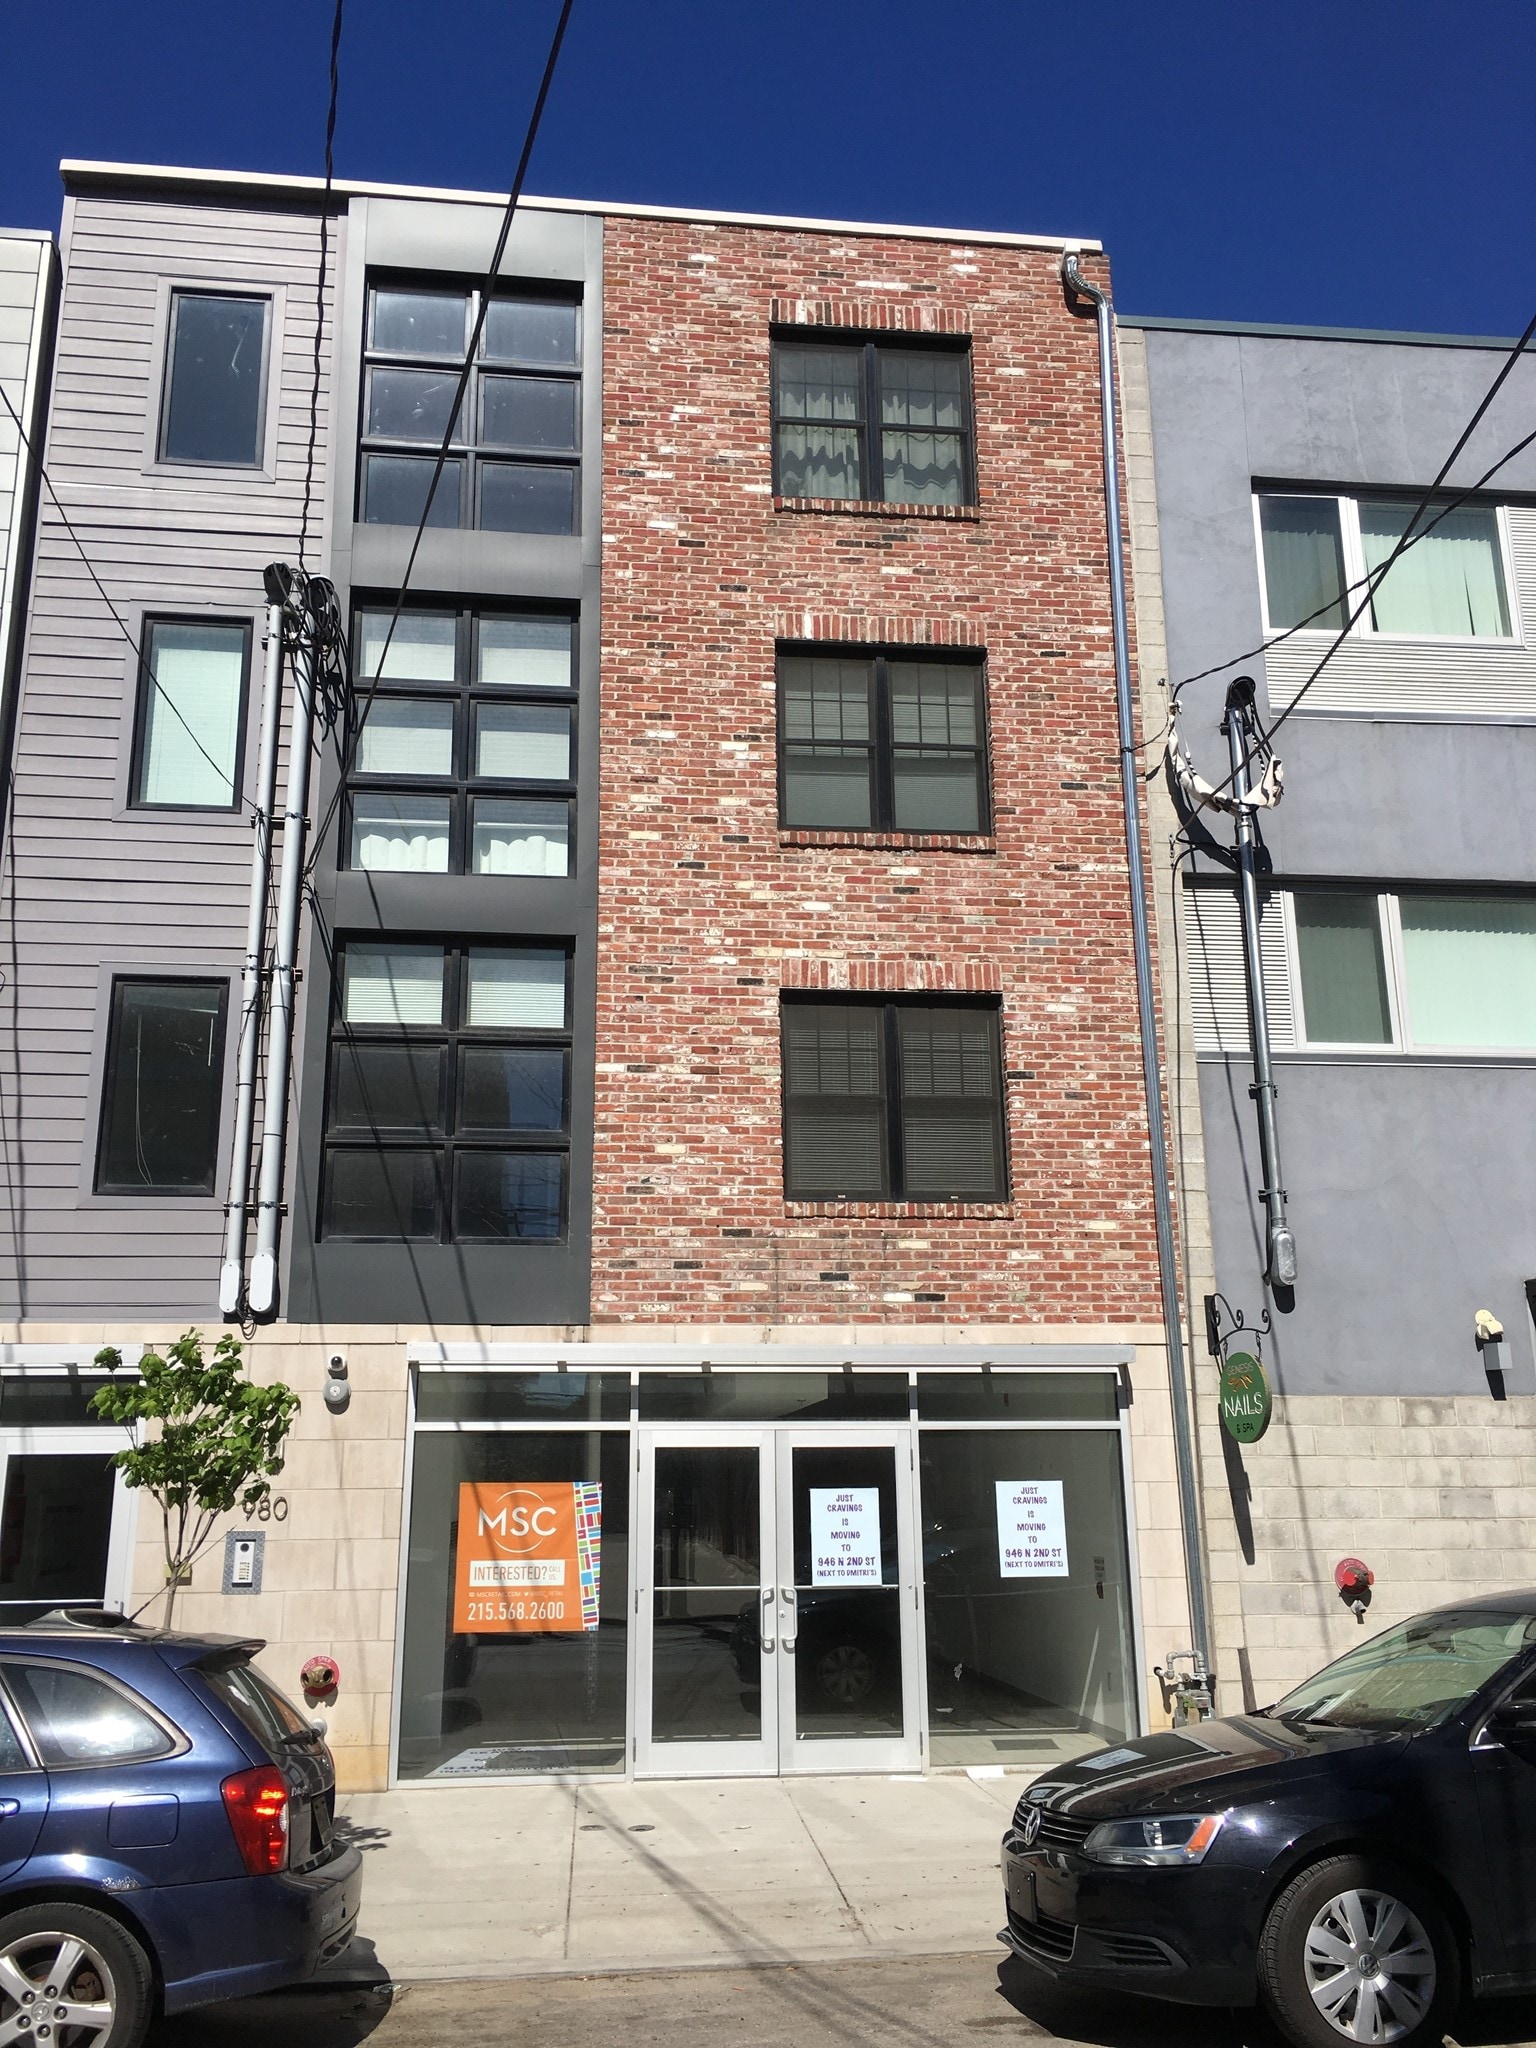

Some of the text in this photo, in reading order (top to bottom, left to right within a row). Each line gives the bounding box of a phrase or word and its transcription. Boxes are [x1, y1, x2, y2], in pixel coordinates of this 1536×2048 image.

[1227, 1362, 1254, 1376] GENESIS
[1224, 1391, 1263, 1418] NAILS
[1243, 1423, 1255, 1433] SPA
[835, 1494, 854, 1502] JUST
[1012, 1496, 1048, 1504] CRAVINGS
[827, 1504, 863, 1512] CRAVINGS
[1027, 1510, 1035, 1518] IS
[478, 1506, 557, 1537] MSC
[842, 1518, 849, 1526] IS
[1016, 1523, 1046, 1531] MOVING
[830, 1531, 861, 1540] MOVING
[1027, 1535, 1038, 1544] TO
[841, 1544, 851, 1552] TO
[1005, 1548, 1062, 1558] 946 N 2ND ST
[817, 1556, 876, 1567] 946 N 2ND ST
[474, 1565, 548, 1581] INTERESTED?
[467, 1601, 565, 1621] 215.568.2600
